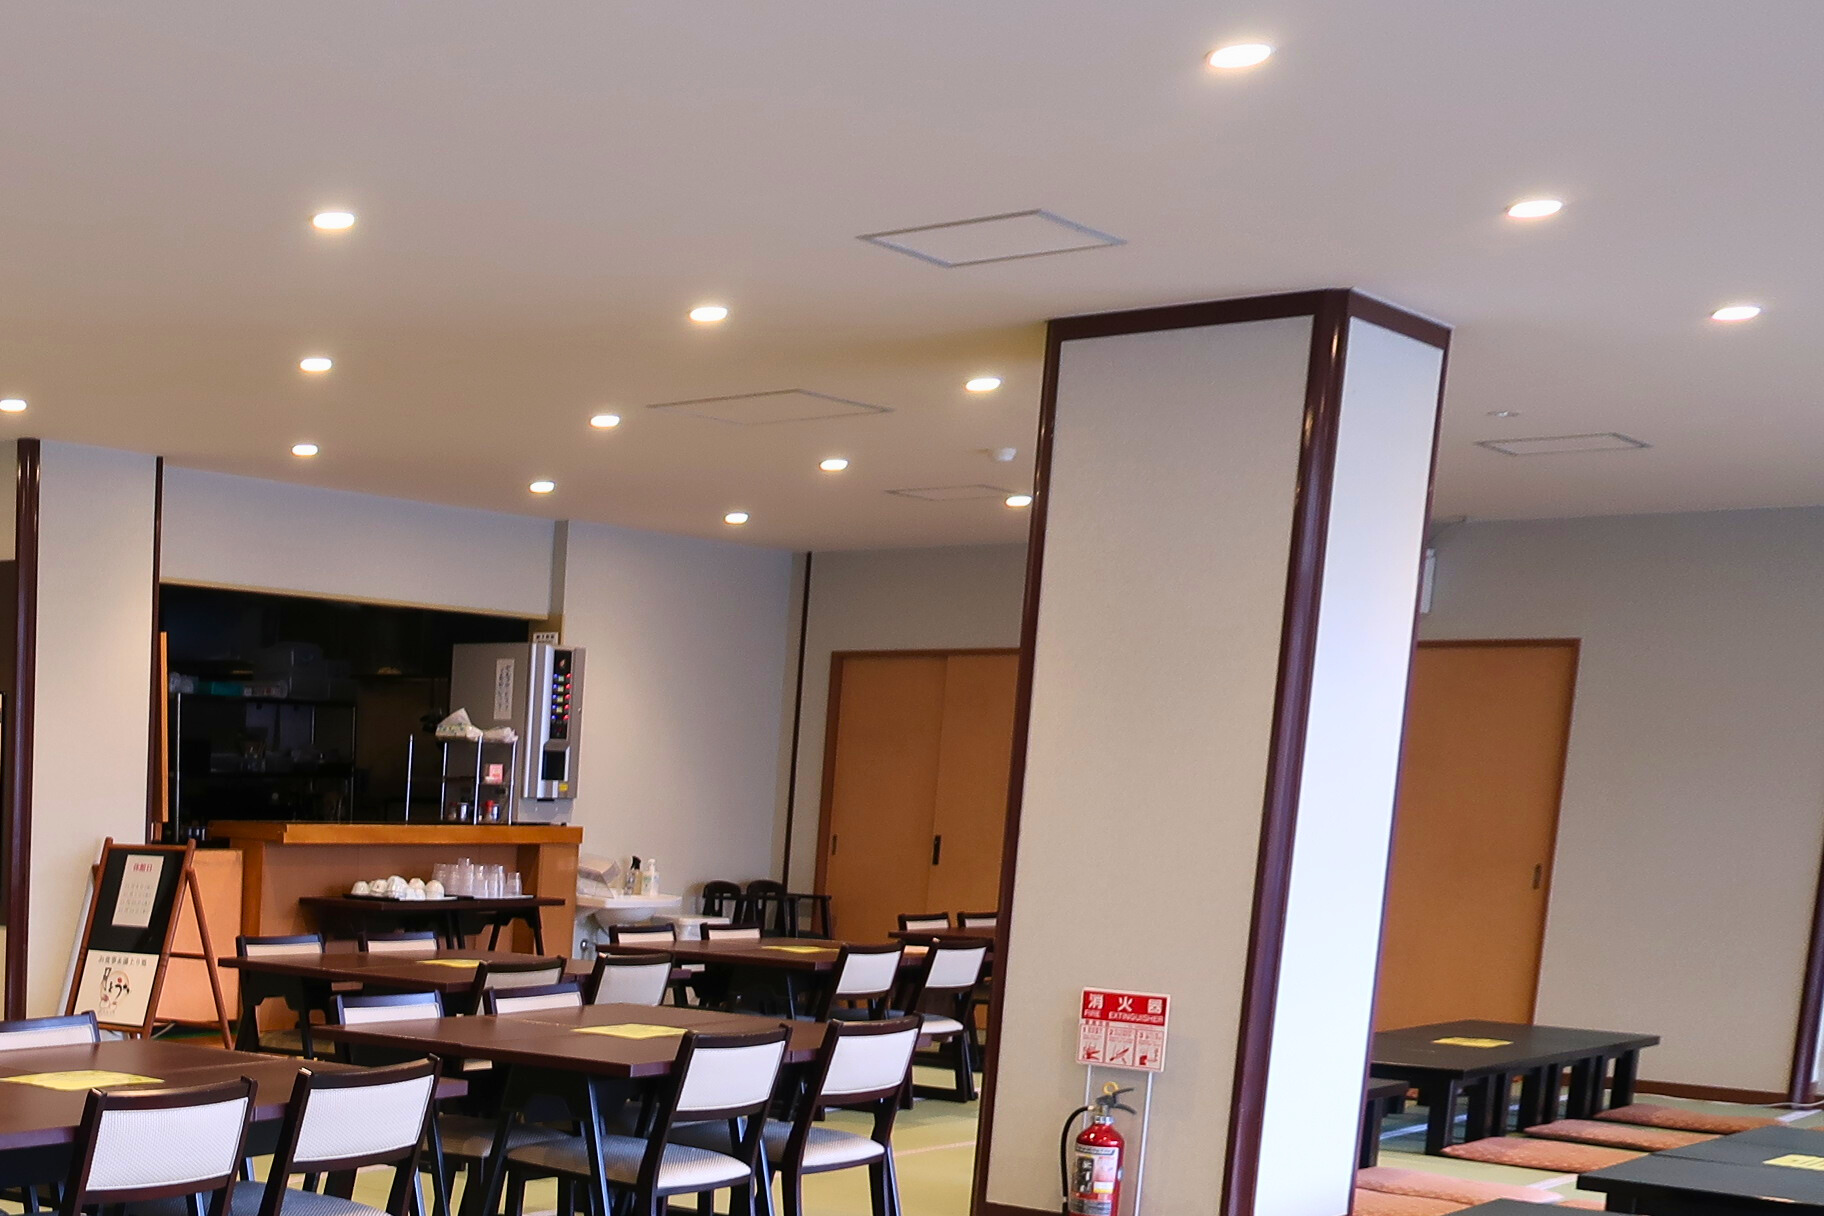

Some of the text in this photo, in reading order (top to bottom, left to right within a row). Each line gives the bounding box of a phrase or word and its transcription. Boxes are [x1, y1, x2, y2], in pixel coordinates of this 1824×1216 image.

[1087, 993, 1163, 1013] 消火器
[1084, 1009, 1164, 1023] FIRE EXTINGUISHER
